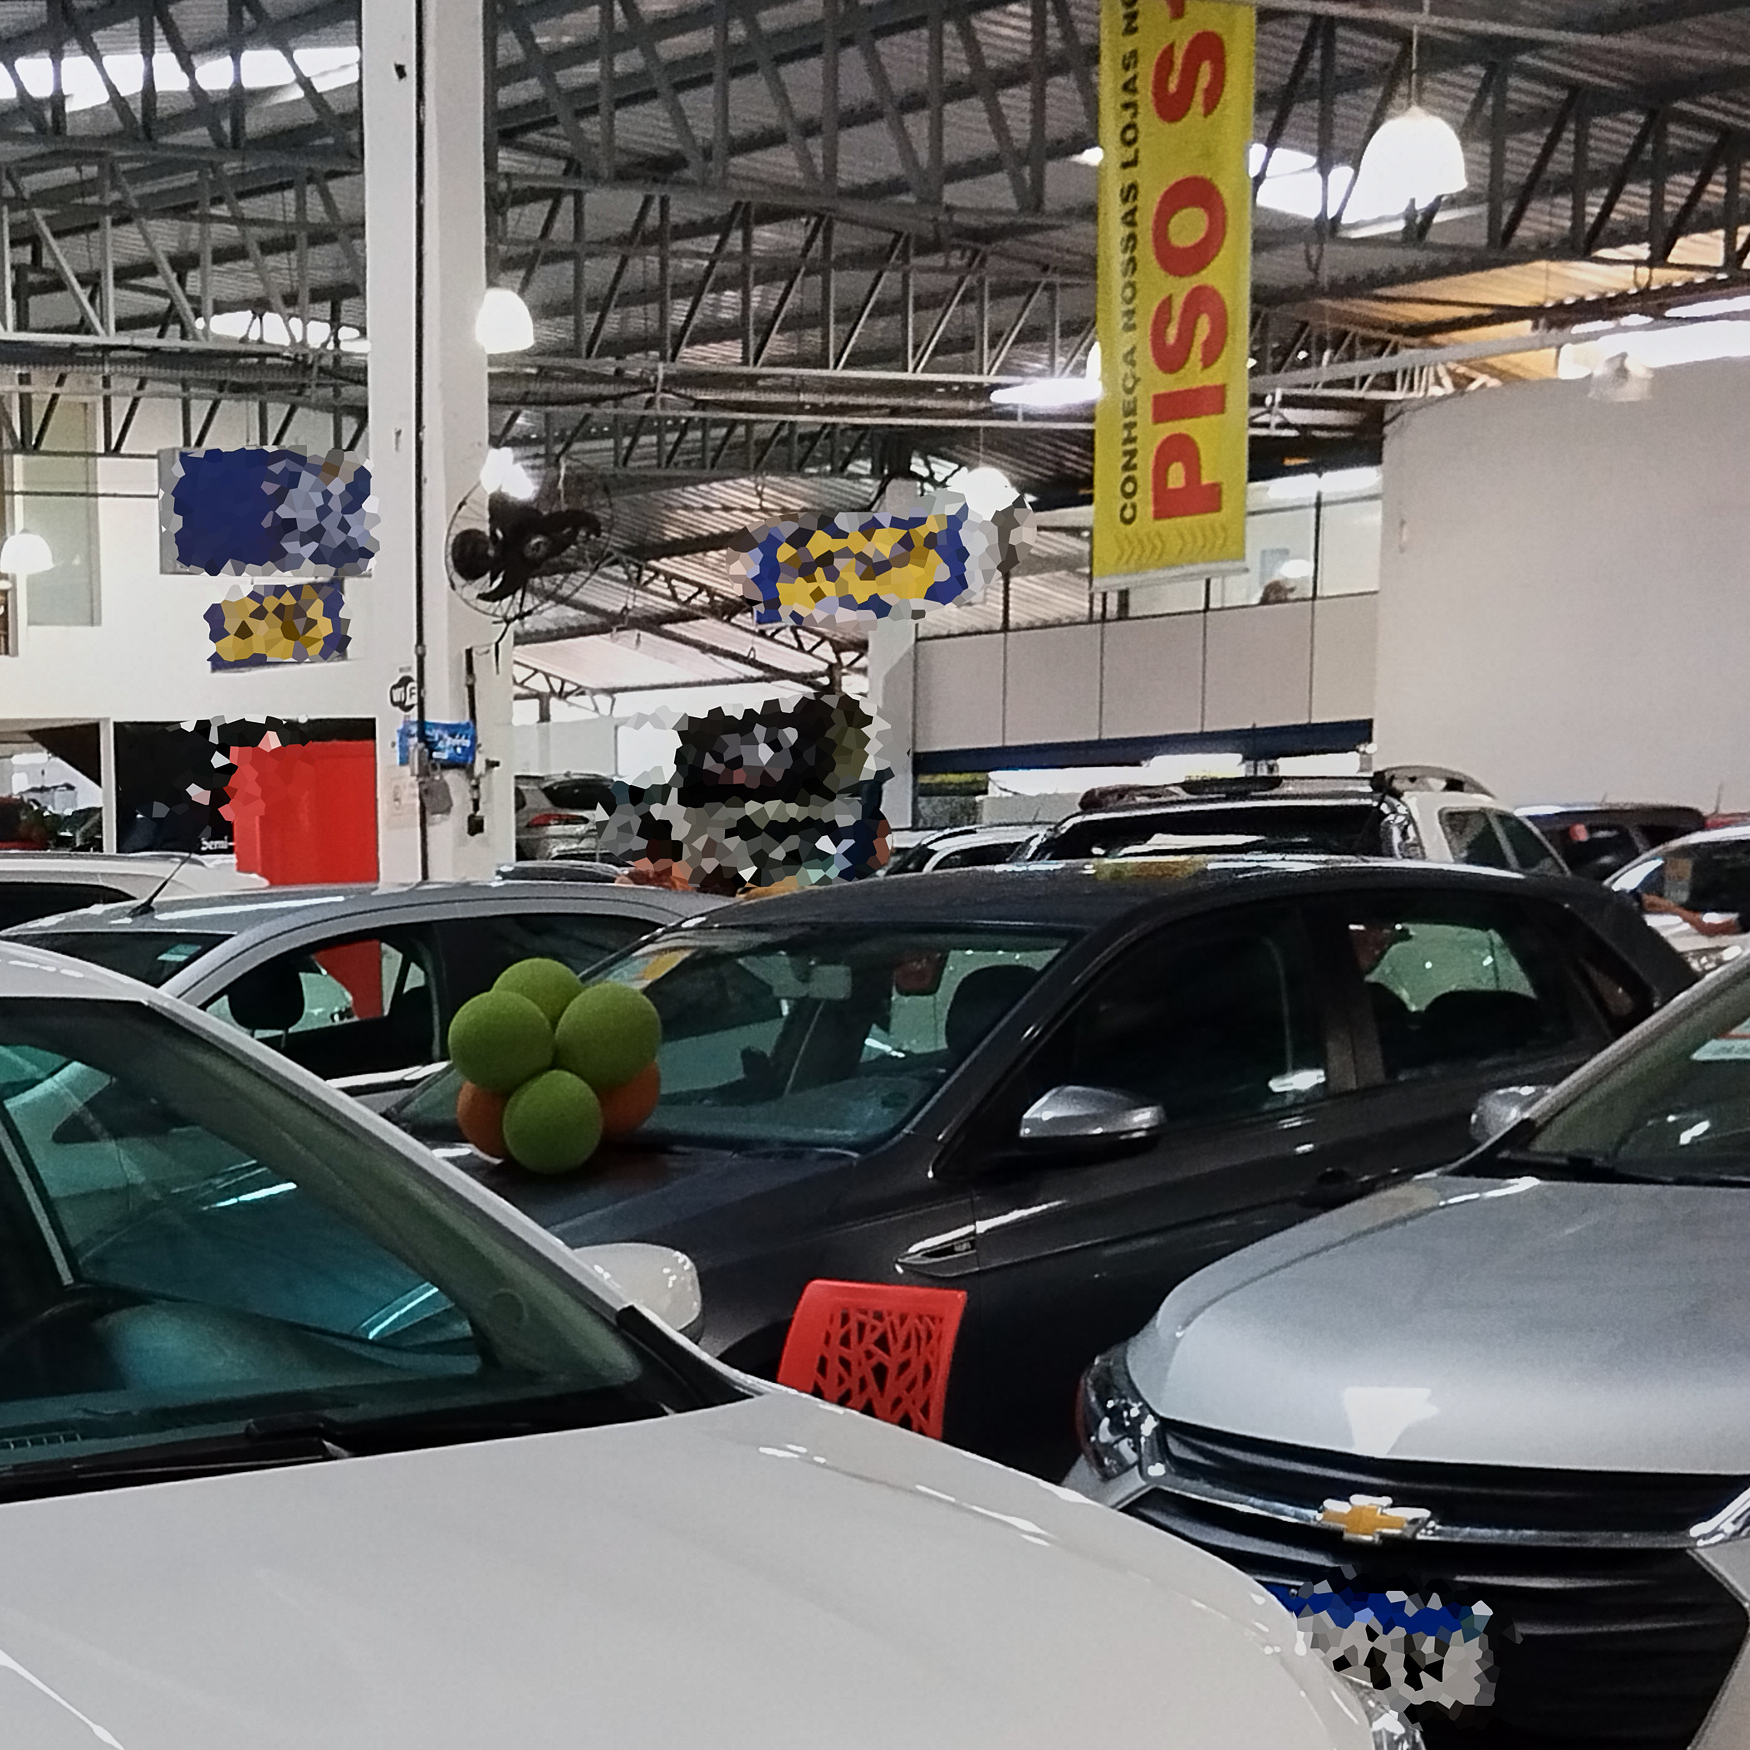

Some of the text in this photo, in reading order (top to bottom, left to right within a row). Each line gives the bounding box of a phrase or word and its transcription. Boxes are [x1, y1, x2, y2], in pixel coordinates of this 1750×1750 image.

[1120, 49, 1139, 170] LOJAS
[1120, 181, 1138, 331] NOSSAS
[1150, 175, 1228, 520] PISO
[1120, 346, 1141, 525] CONHEÇA
